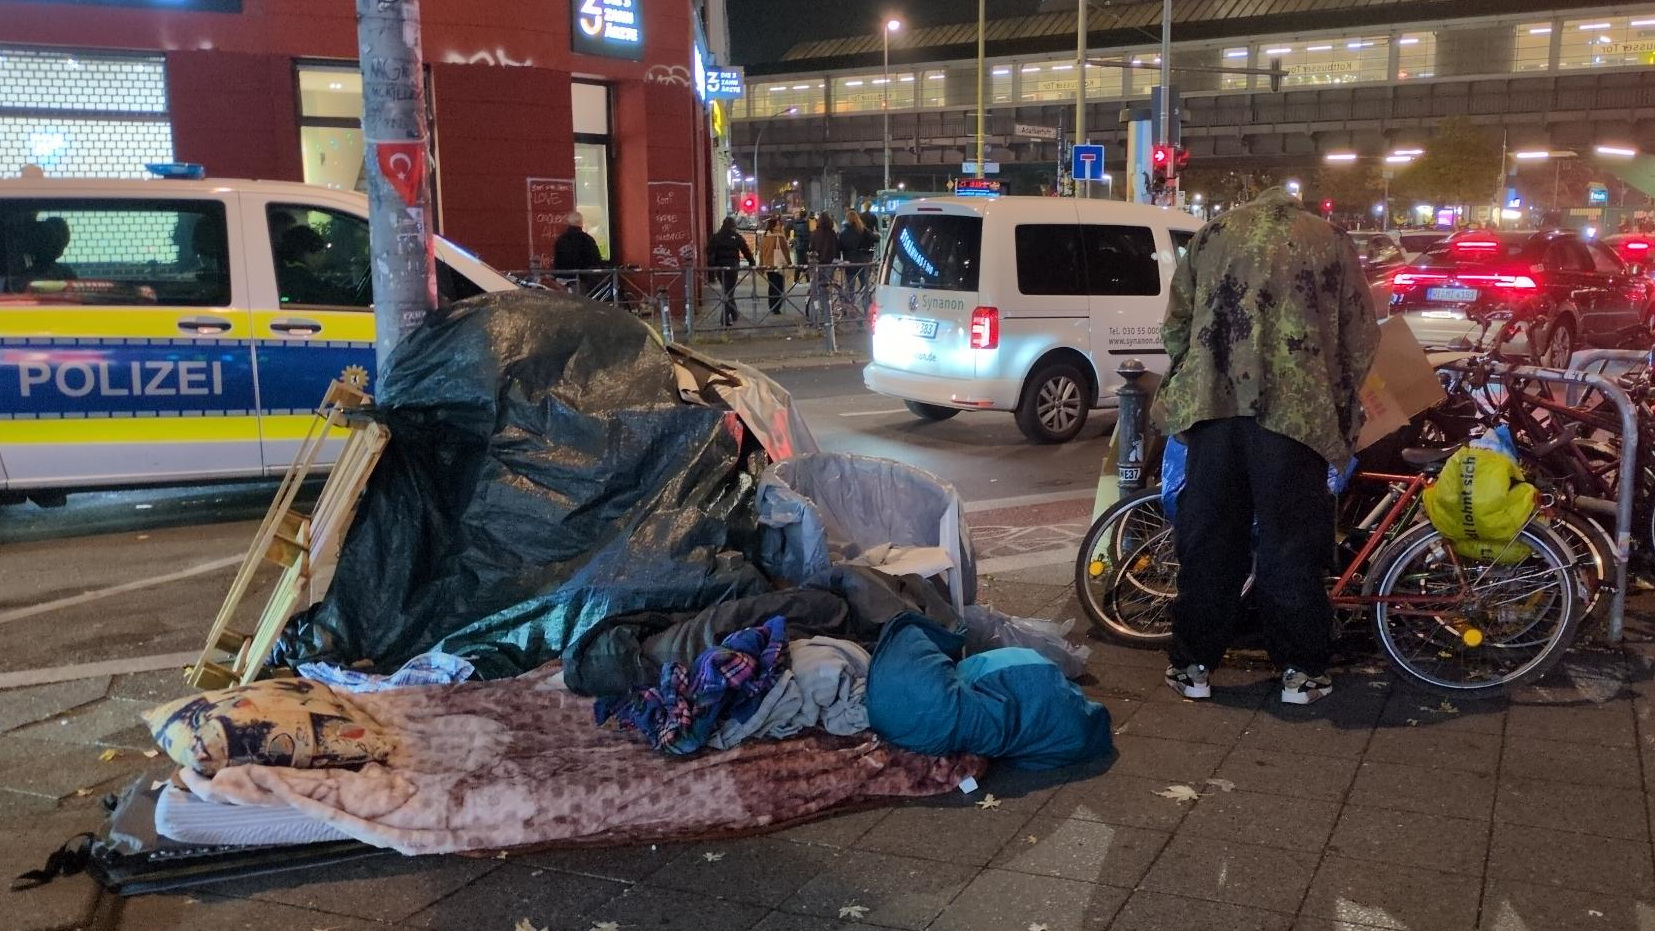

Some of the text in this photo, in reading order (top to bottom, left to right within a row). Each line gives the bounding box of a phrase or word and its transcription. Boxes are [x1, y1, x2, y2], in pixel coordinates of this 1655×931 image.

[922, 294, 964, 311] Synanon
[1122, 327, 1135, 335] 030
[1137, 327, 1146, 335] 55
[1147, 326, 1160, 335] 000
[19, 360, 223, 397] POLIZEI
[1460, 456, 1479, 541] dl lohnt sich
